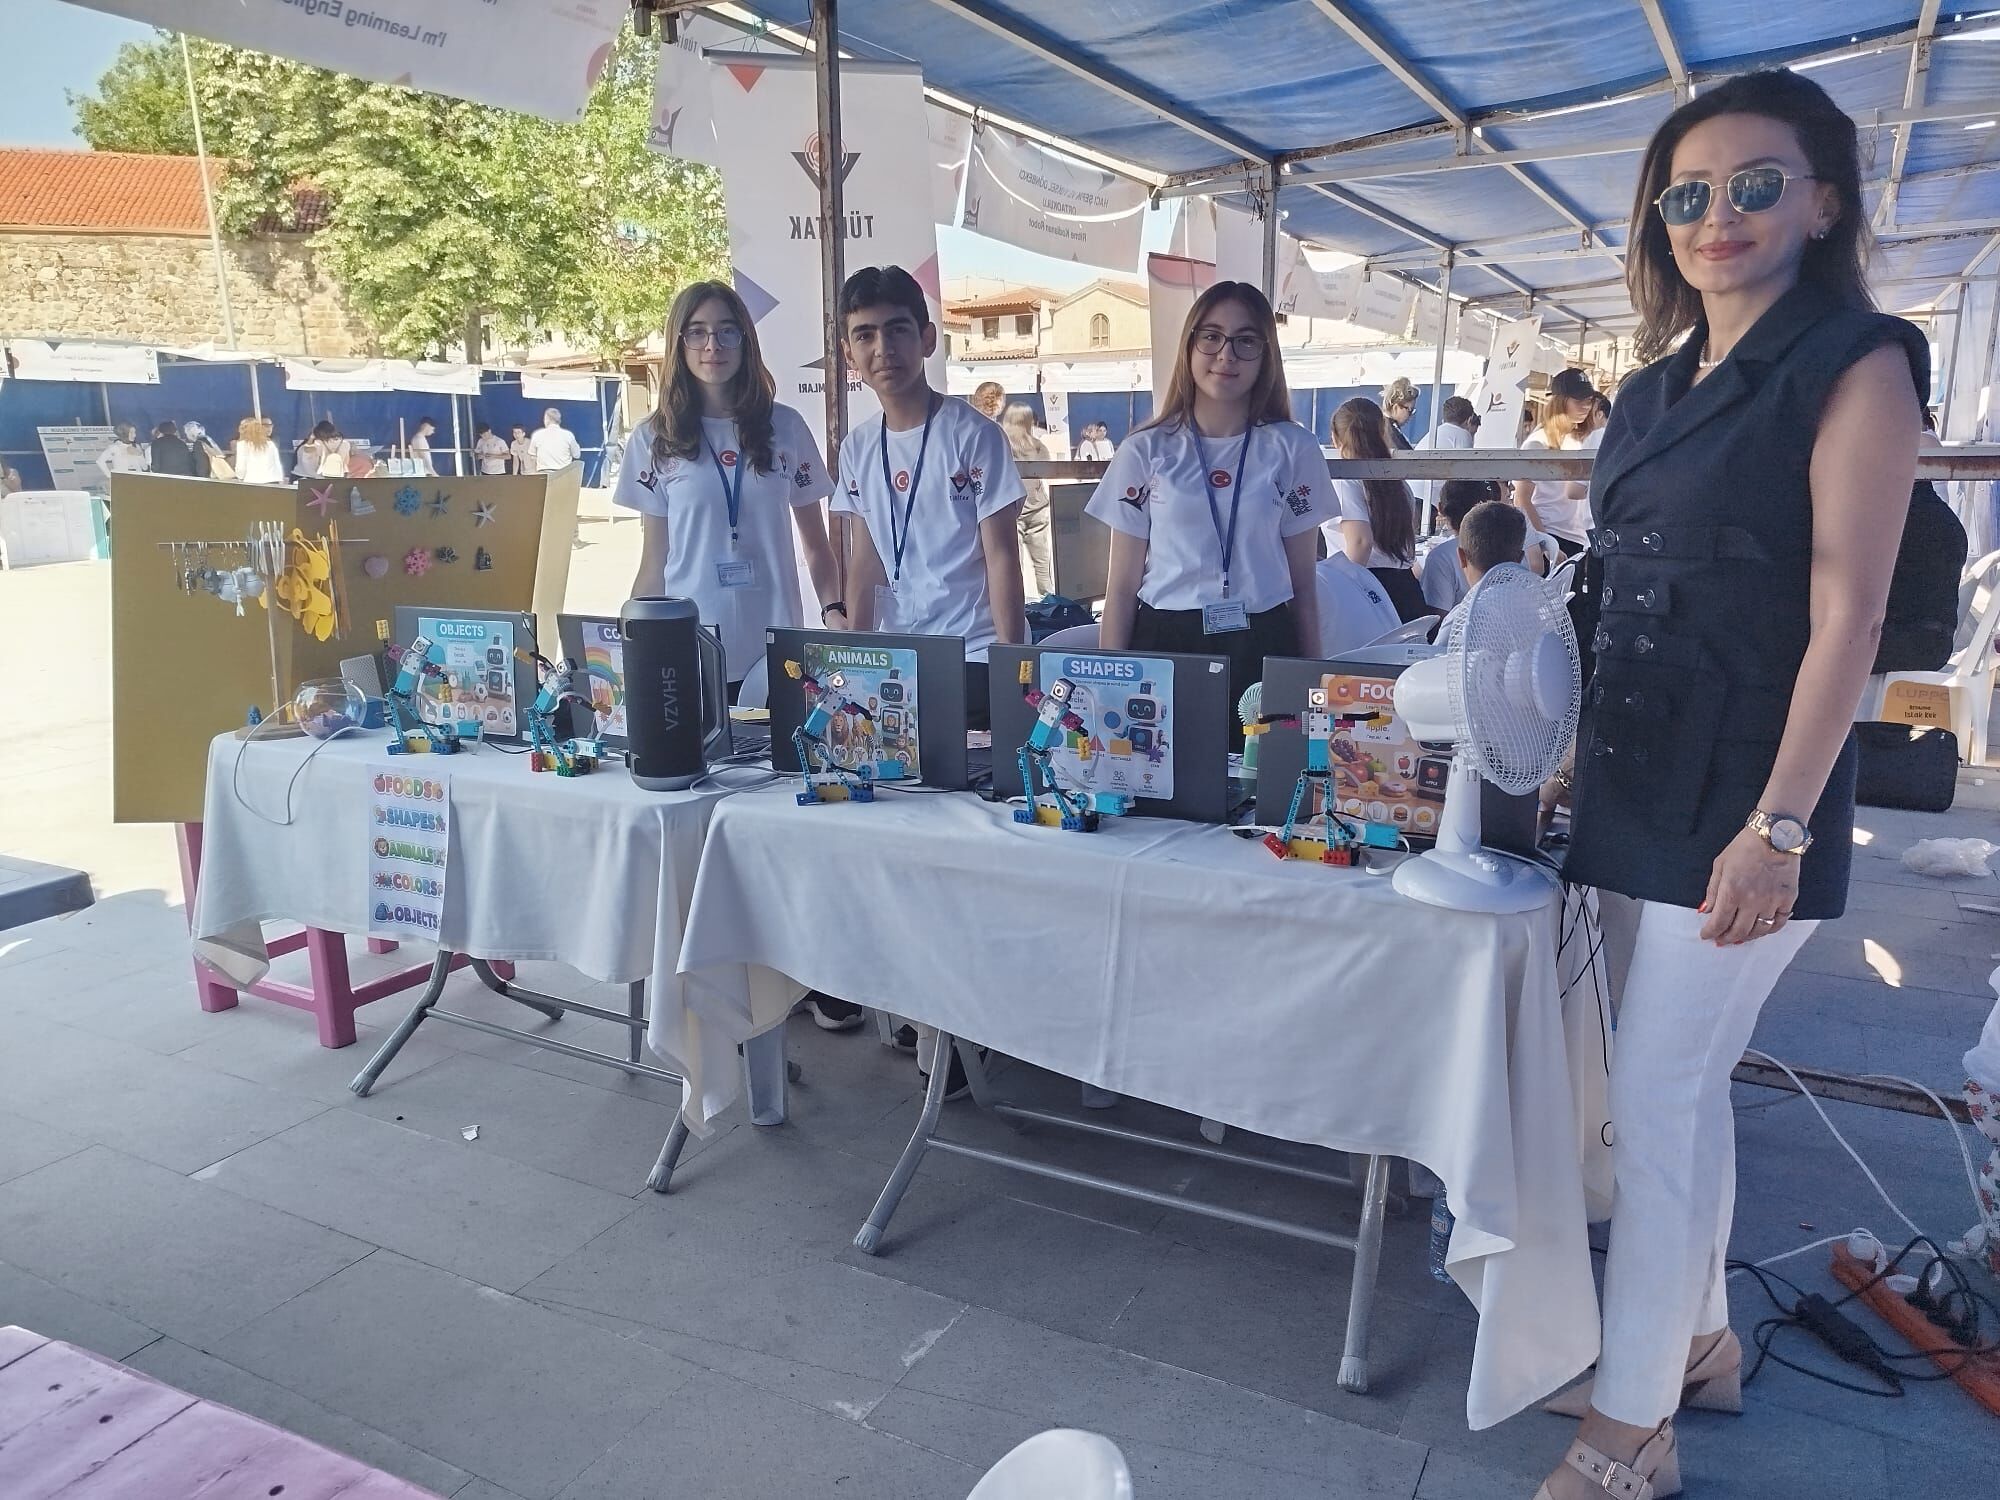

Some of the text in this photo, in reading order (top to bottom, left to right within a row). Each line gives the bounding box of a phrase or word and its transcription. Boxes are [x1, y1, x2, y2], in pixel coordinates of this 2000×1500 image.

[439, 623, 484, 637] OBJECTS
[828, 650, 888, 667] ANIMALS
[1070, 660, 1135, 678] SHAPES
[1359, 682, 1394, 700] FOO
[384, 775, 433, 799] FOODS
[386, 807, 436, 831] SHAPES
[389, 840, 434, 864] ANIMALS
[392, 872, 437, 896] COLORS
[394, 905, 438, 930] OBJECTS
